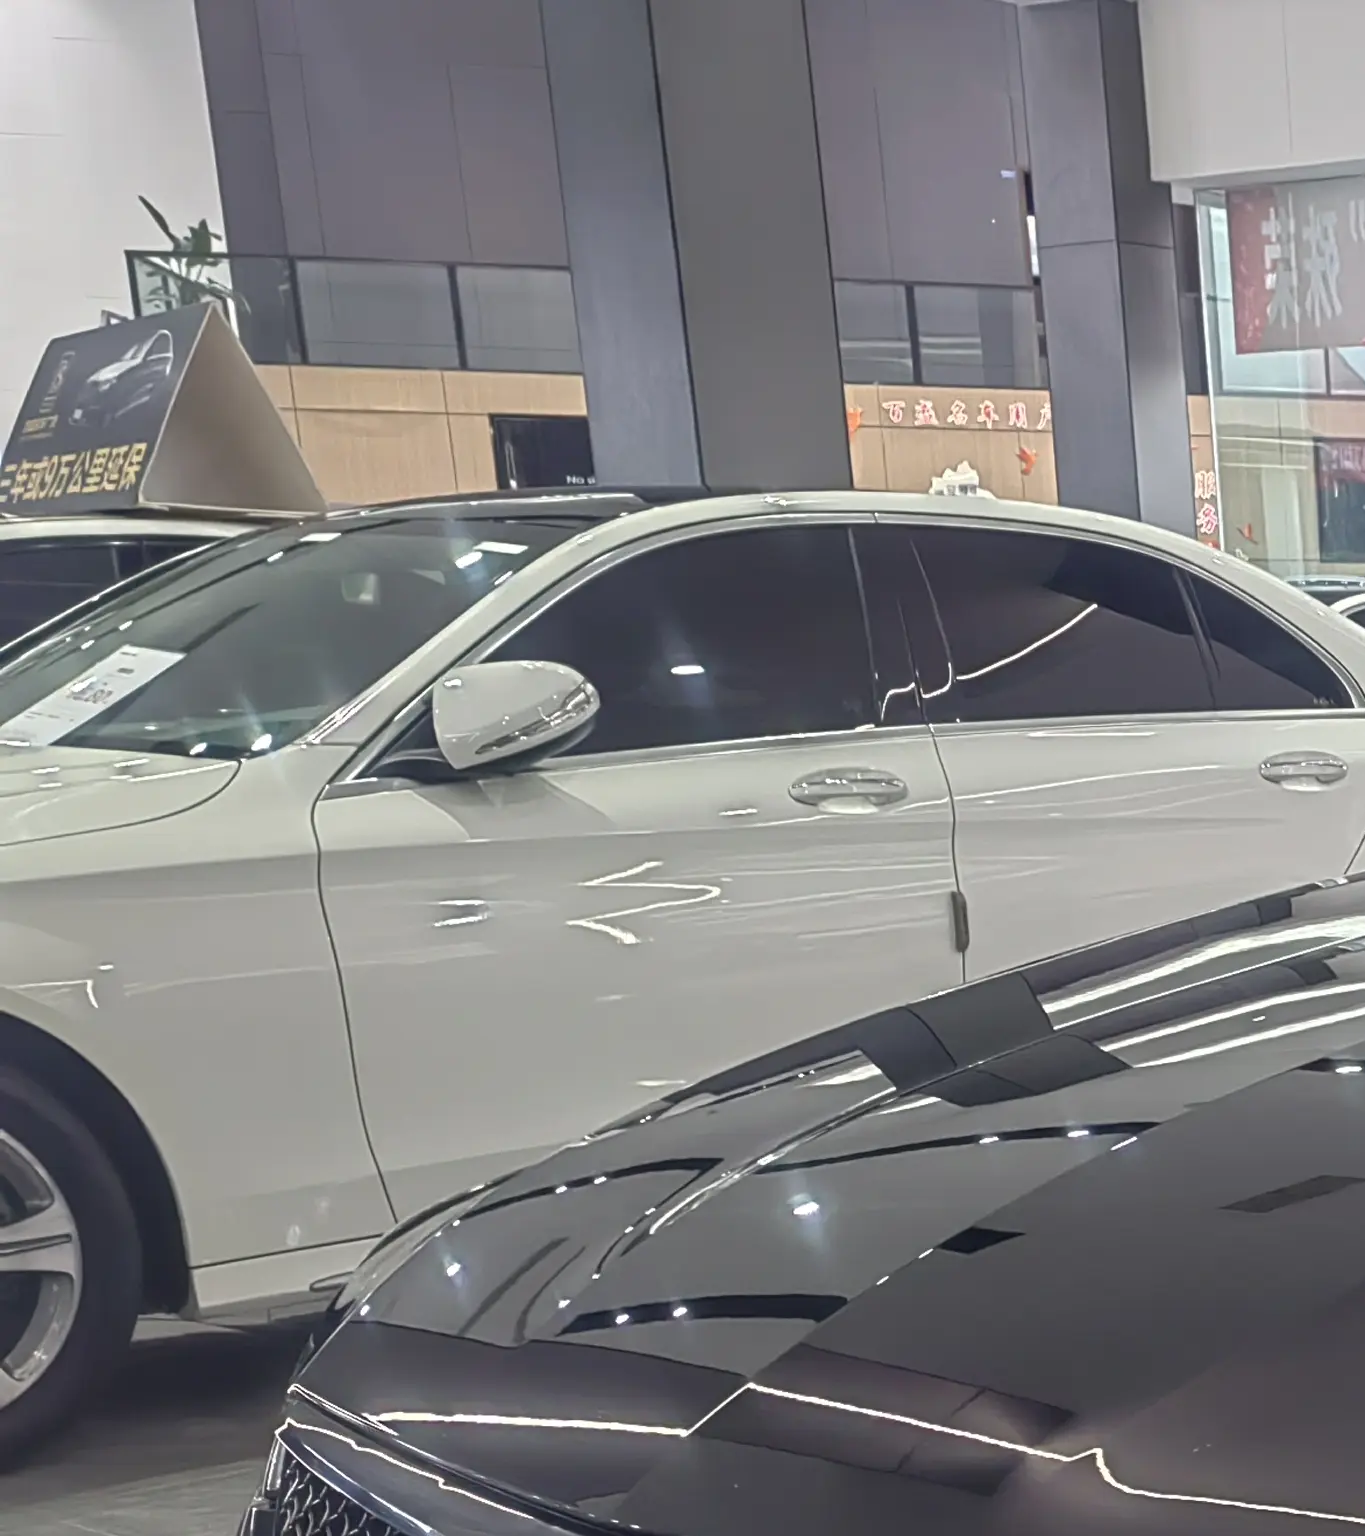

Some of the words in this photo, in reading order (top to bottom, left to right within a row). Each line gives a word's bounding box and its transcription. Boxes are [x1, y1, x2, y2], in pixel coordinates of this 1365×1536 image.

[0, 442, 148, 504] 三年或9万公里延保
